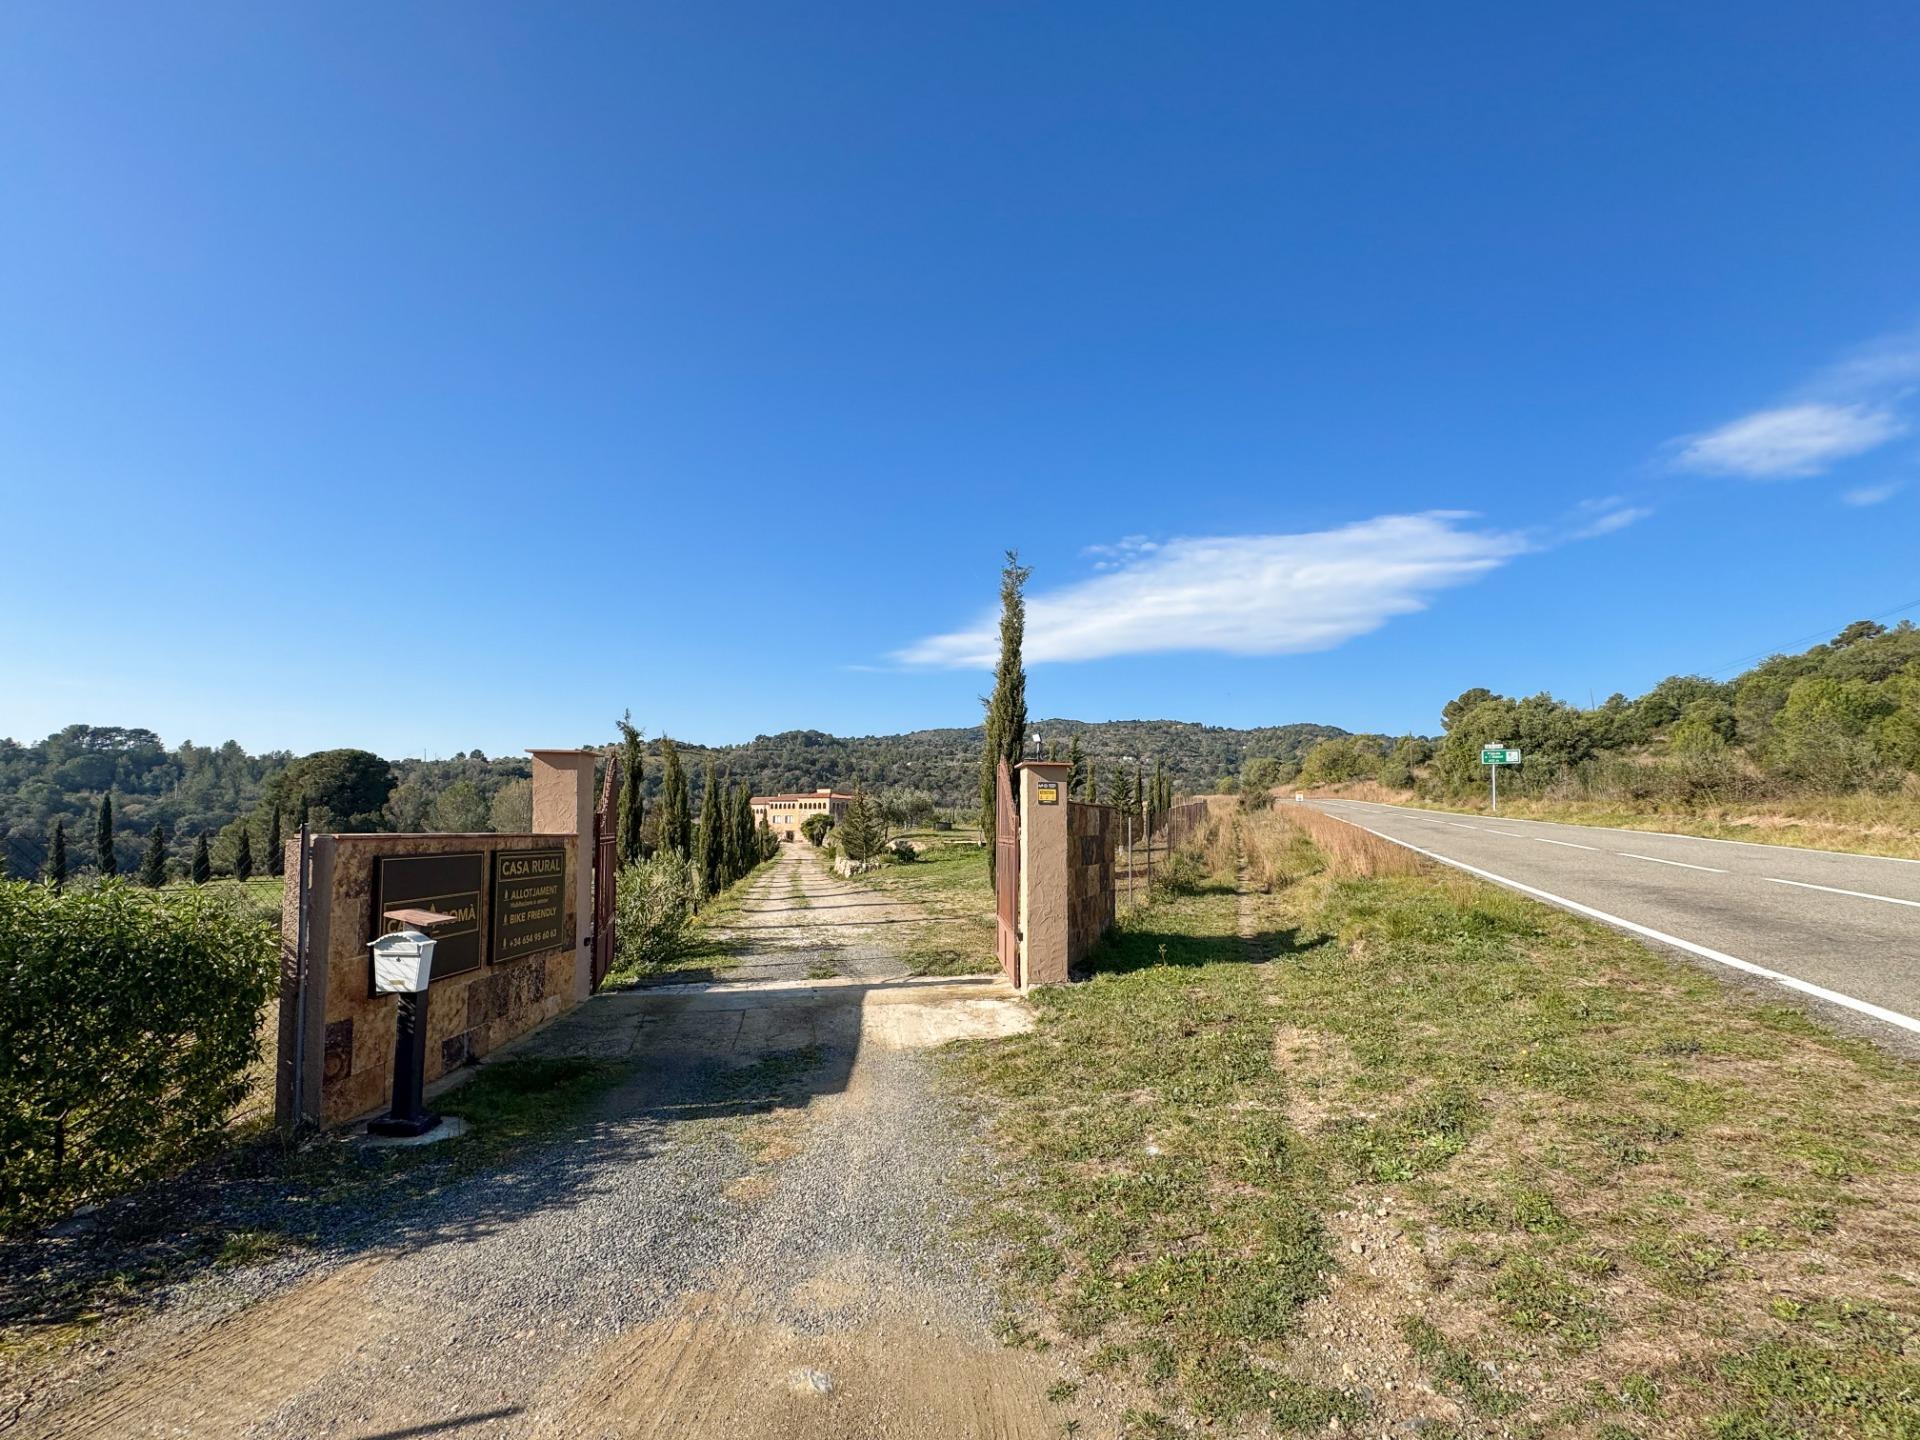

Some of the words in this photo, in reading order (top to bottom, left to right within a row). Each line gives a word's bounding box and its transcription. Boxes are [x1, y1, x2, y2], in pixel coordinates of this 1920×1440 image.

[502, 860, 530, 876] CASA
[531, 859, 561, 873] RURAL
[511, 885, 558, 900] ALLOTJAMENT
[509, 912, 526, 925] BIKE
[527, 907, 557, 920] FRIENDLY
